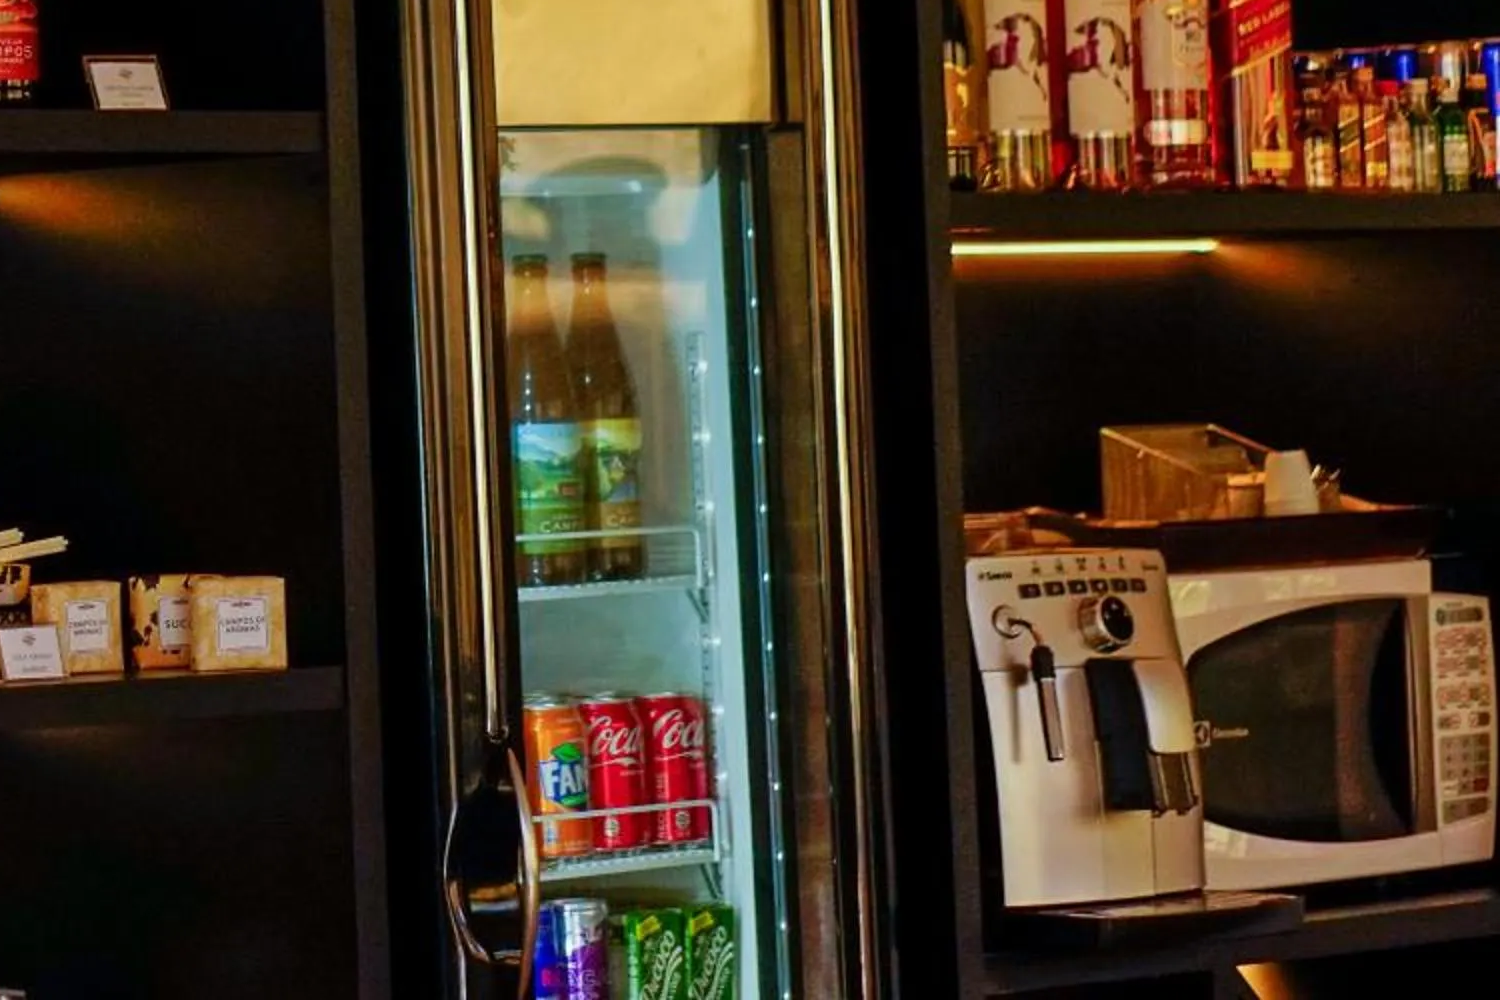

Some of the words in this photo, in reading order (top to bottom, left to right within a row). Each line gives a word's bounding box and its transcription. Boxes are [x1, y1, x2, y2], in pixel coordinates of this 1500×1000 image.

[586, 714, 642, 757] Coca
[652, 708, 705, 752] Coca
[541, 760, 587, 799] FAN
